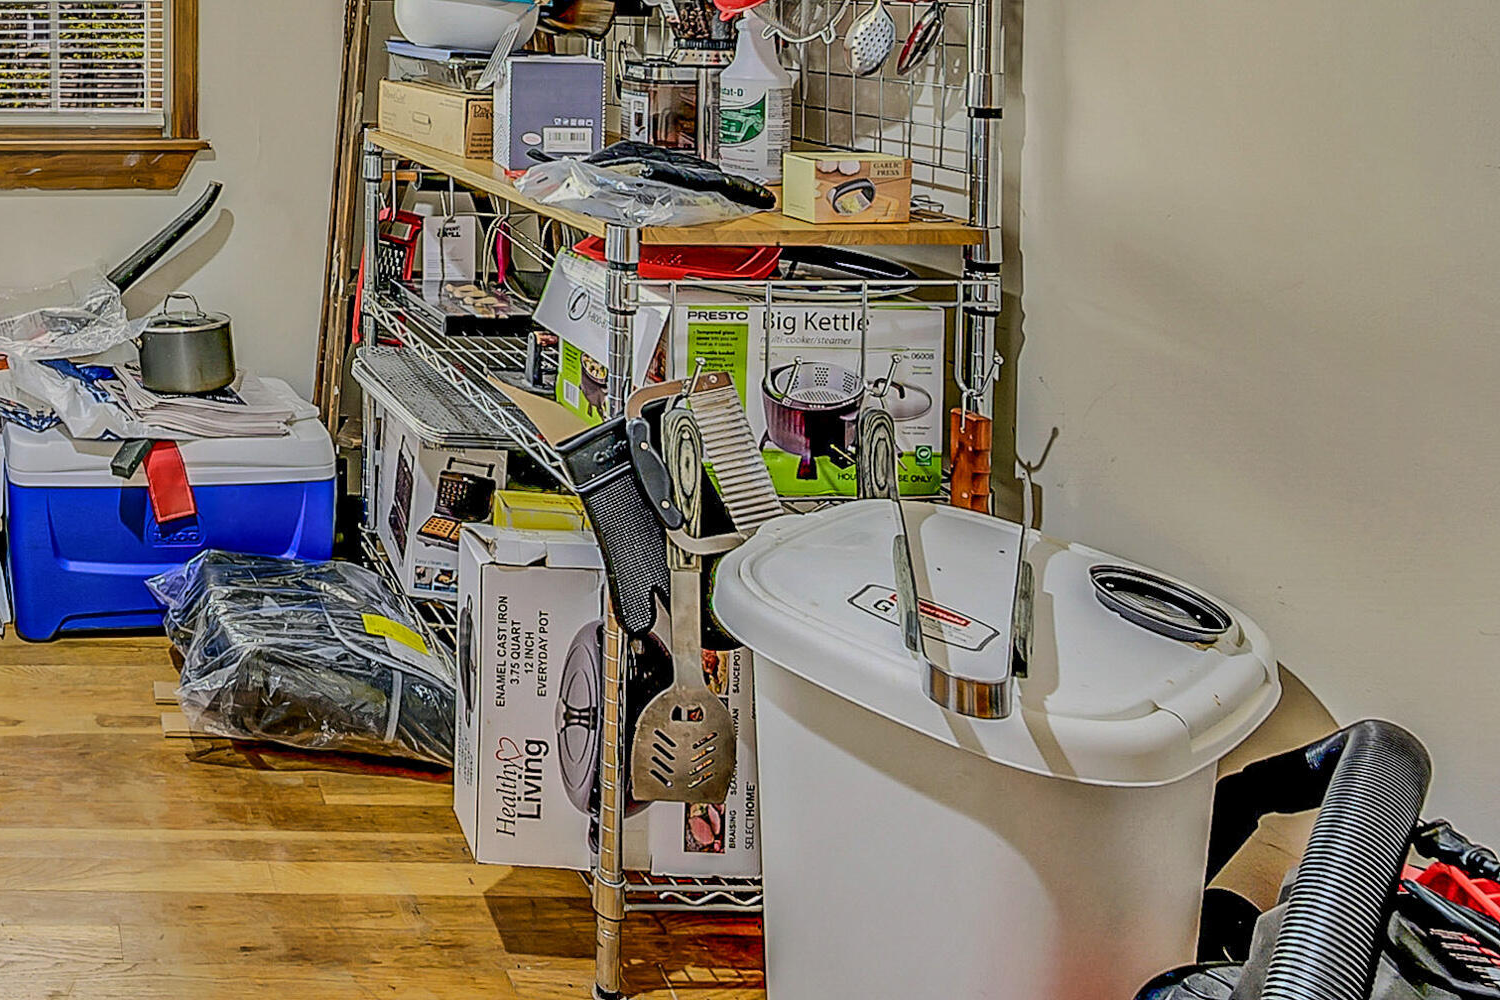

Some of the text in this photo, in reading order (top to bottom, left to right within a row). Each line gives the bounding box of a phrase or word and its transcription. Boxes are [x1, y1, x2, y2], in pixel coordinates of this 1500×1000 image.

[873, 161, 901, 169] GARLIC
[687, 311, 749, 321] PRESTO
[762, 311, 870, 335] Big Kettle
[760, 336, 852, 345] mlti-cooker/steamer
[910, 475, 933, 483] ONLY
[496, 595, 508, 707] ENAMEL CAST IRON
[510, 620, 521, 685] 3.75 QUART
[524, 631, 535, 674] 12 INCH
[537, 610, 549, 697] EVERYDAY POT
[496, 758, 523, 837] Healthy
[517, 738, 550, 820] Living
[729, 809, 737, 849] BRAISING
[745, 783, 756, 850] SELECTHOME
